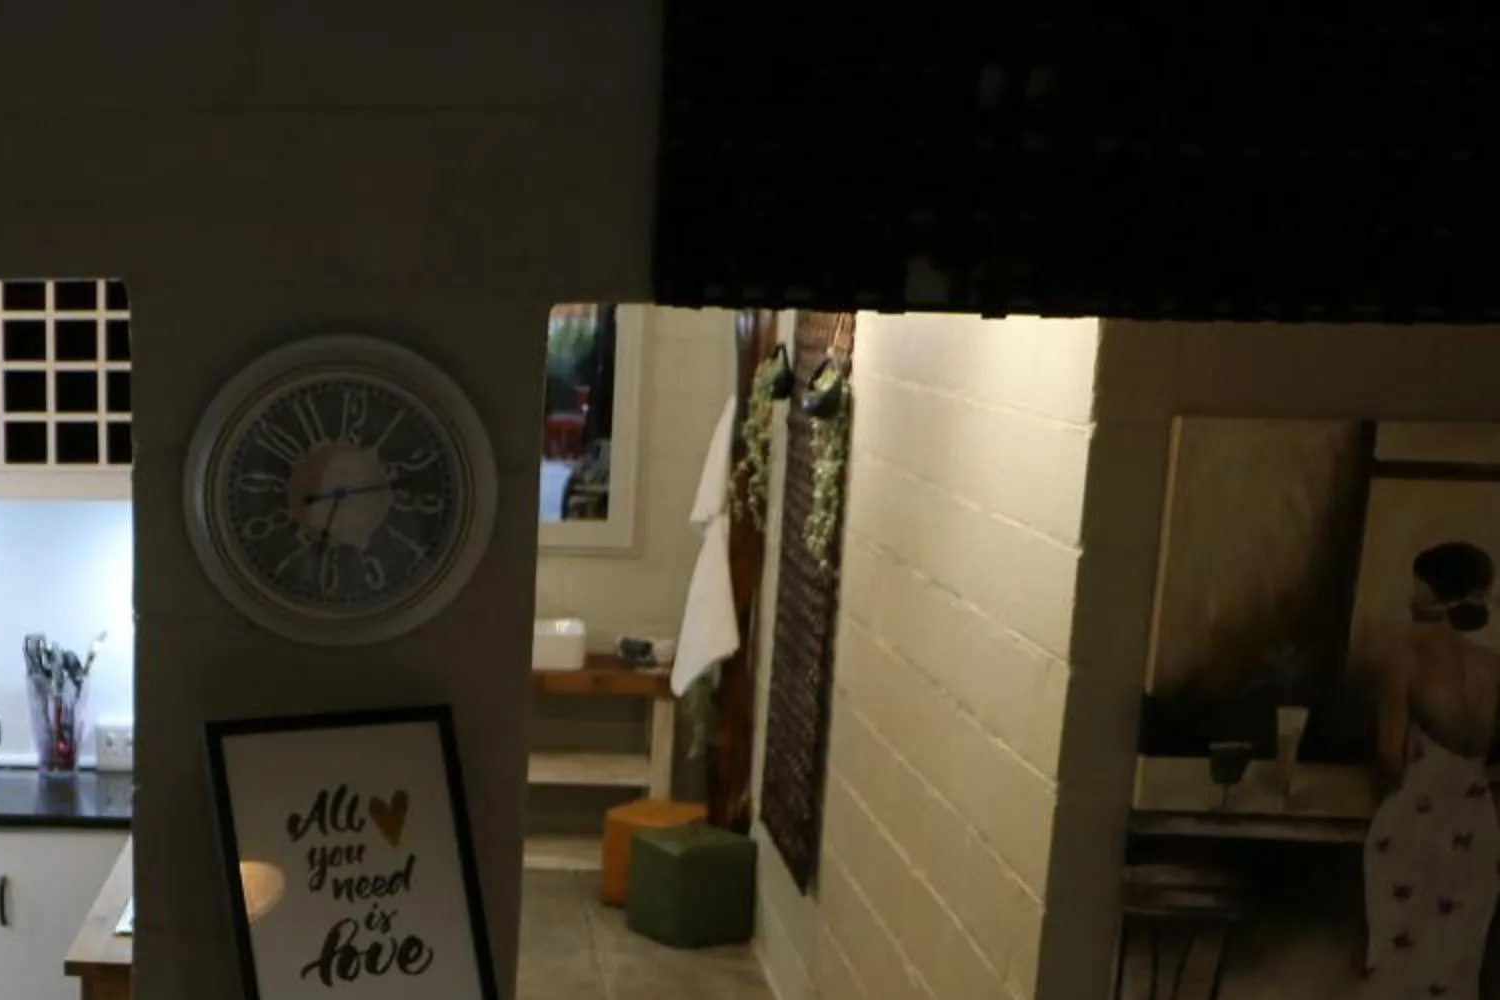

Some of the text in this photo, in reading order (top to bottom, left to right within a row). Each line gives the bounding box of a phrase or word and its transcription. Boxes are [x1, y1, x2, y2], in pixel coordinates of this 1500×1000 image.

[286, 784, 365, 841] All
[307, 844, 366, 892] you
[333, 853, 417, 902] need
[364, 903, 397, 933] is
